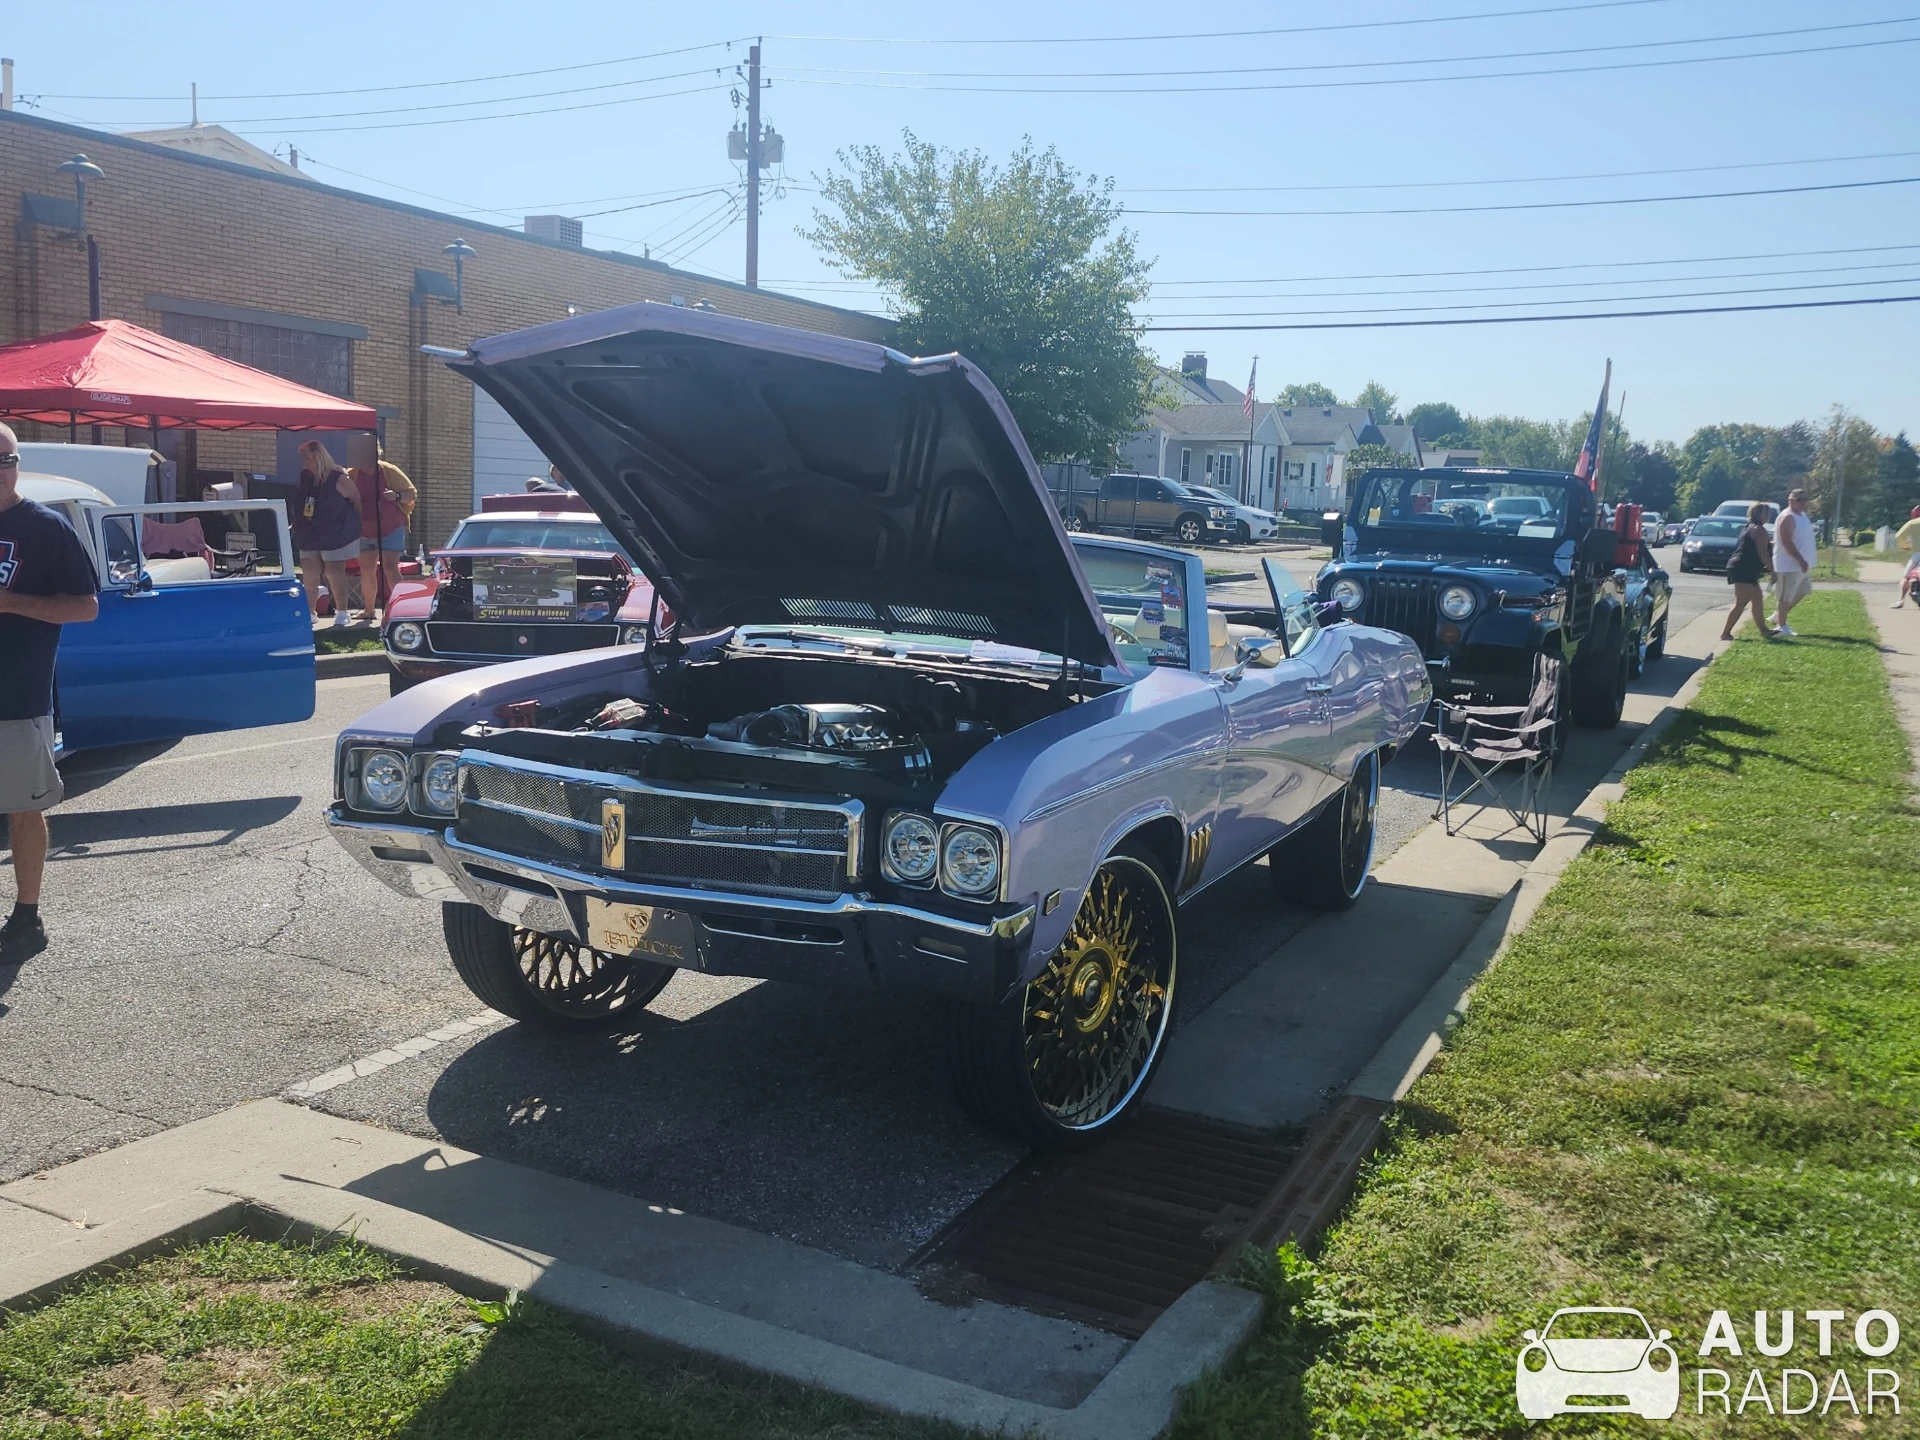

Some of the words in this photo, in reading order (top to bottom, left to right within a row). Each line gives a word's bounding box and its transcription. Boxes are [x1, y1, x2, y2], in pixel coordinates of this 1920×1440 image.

[479, 608, 505, 618] Street
[507, 608, 535, 617] Machine
[537, 608, 570, 617] Nationals
[604, 930, 685, 960] BUICK
